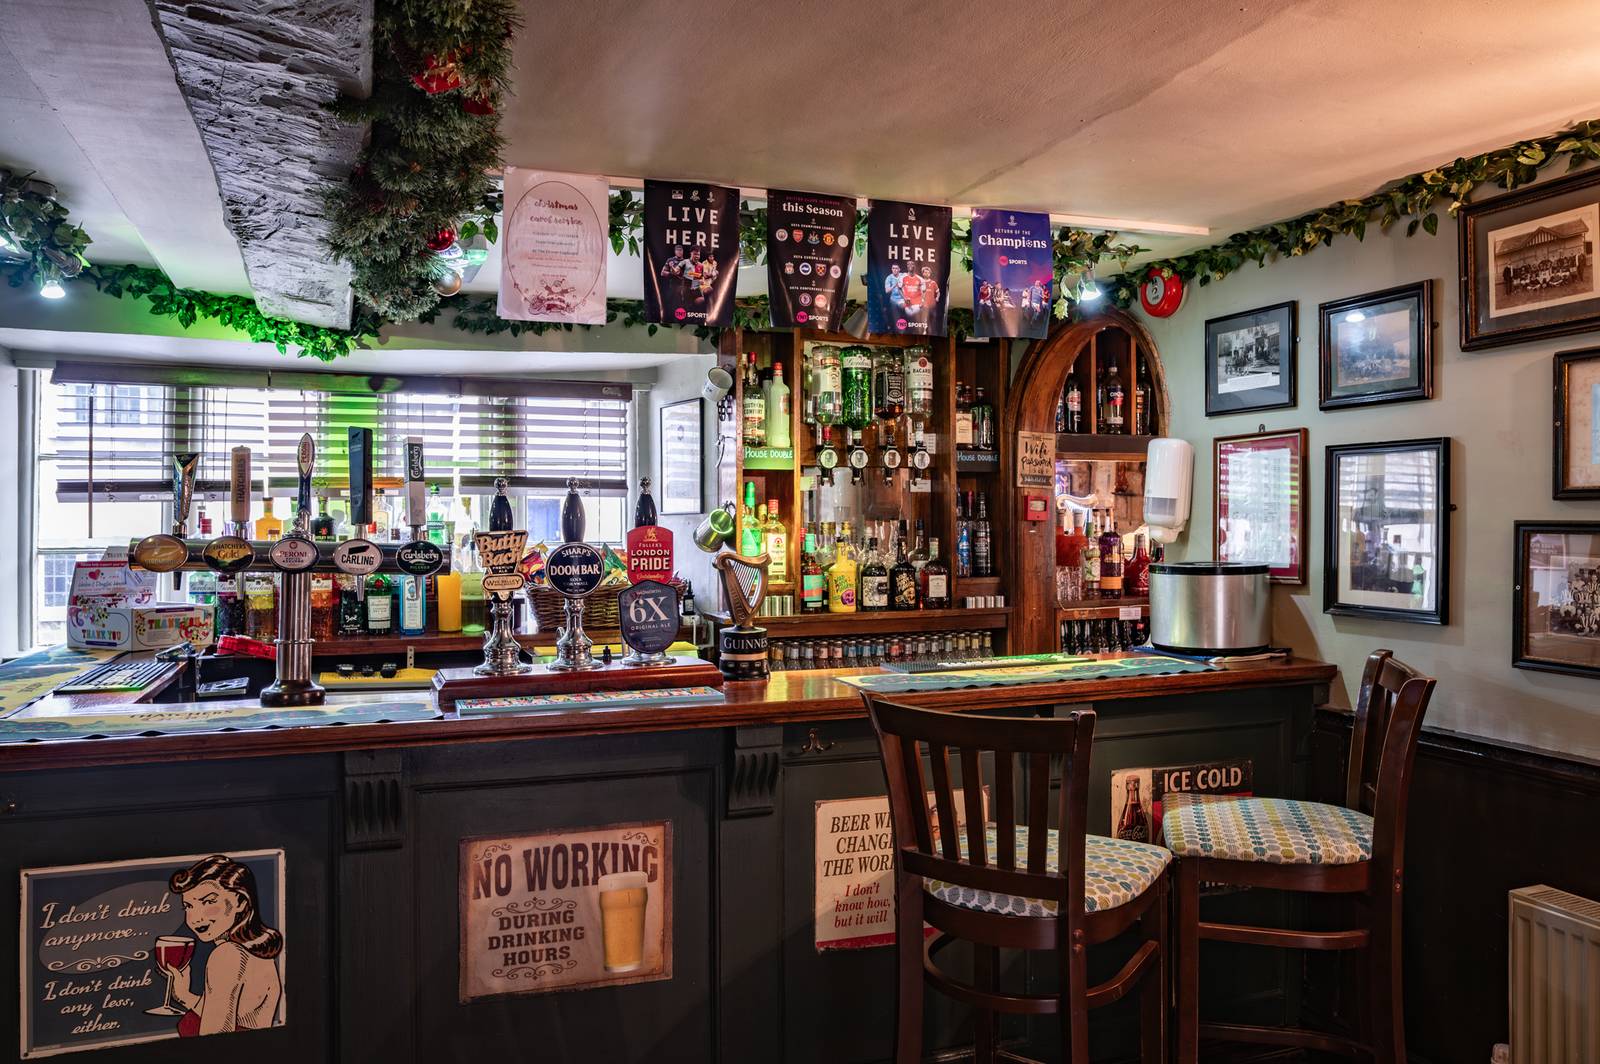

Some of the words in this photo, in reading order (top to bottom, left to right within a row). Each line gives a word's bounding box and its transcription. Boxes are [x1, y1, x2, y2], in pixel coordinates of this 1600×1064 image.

[667, 205, 718, 225] LIVE
[782, 202, 804, 213] this
[806, 204, 844, 217] Season
[666, 229, 720, 248] HERE
[889, 223, 934, 241] LIVE
[978, 234, 1047, 249] Champions
[888, 245, 936, 262] HERE
[479, 533, 528, 552] Butty
[217, 549, 240, 559] Gold
[279, 550, 307, 558] PERONI
[341, 554, 374, 566] CARLING
[402, 549, 439, 561] Carlsberg
[481, 548, 522, 567] Bach
[561, 547, 592, 558] SHARP'S
[631, 549, 670, 557] LONDON
[550, 565, 580, 576] DOOM
[581, 563, 600, 575] BAR
[631, 557, 670, 571] PRIDE
[629, 596, 670, 624] 6X
[82, 629, 105, 640] THANK
[108, 630, 122, 640] YOU
[1164, 771, 1191, 793] ICE
[1197, 767, 1242, 790] COLD
[830, 813, 870, 834] BEER
[875, 812, 892, 829] WI
[472, 853, 512, 900] NO
[523, 841, 658, 893] WORKING
[824, 857, 853, 877] THE
[845, 884, 852, 897] I
[852, 881, 880, 895] don't
[40, 903, 60, 929] I
[58, 904, 110, 925] don't
[117, 892, 172, 918] drink
[834, 900, 865, 912] know
[867, 897, 891, 908] how,
[499, 910, 575, 931] DURING
[834, 915, 852, 928] but
[856, 914, 864, 925] it
[866, 911, 888, 924] will
[44, 927, 149, 951] anymore...
[488, 926, 585, 950] DRINKING
[503, 946, 571, 967] HOURS
[42, 980, 57, 1001] I
[56, 979, 102, 997] don't
[108, 969, 153, 991] drink
[60, 1003, 94, 1017] any
[71, 1014, 121, 1035] either.
